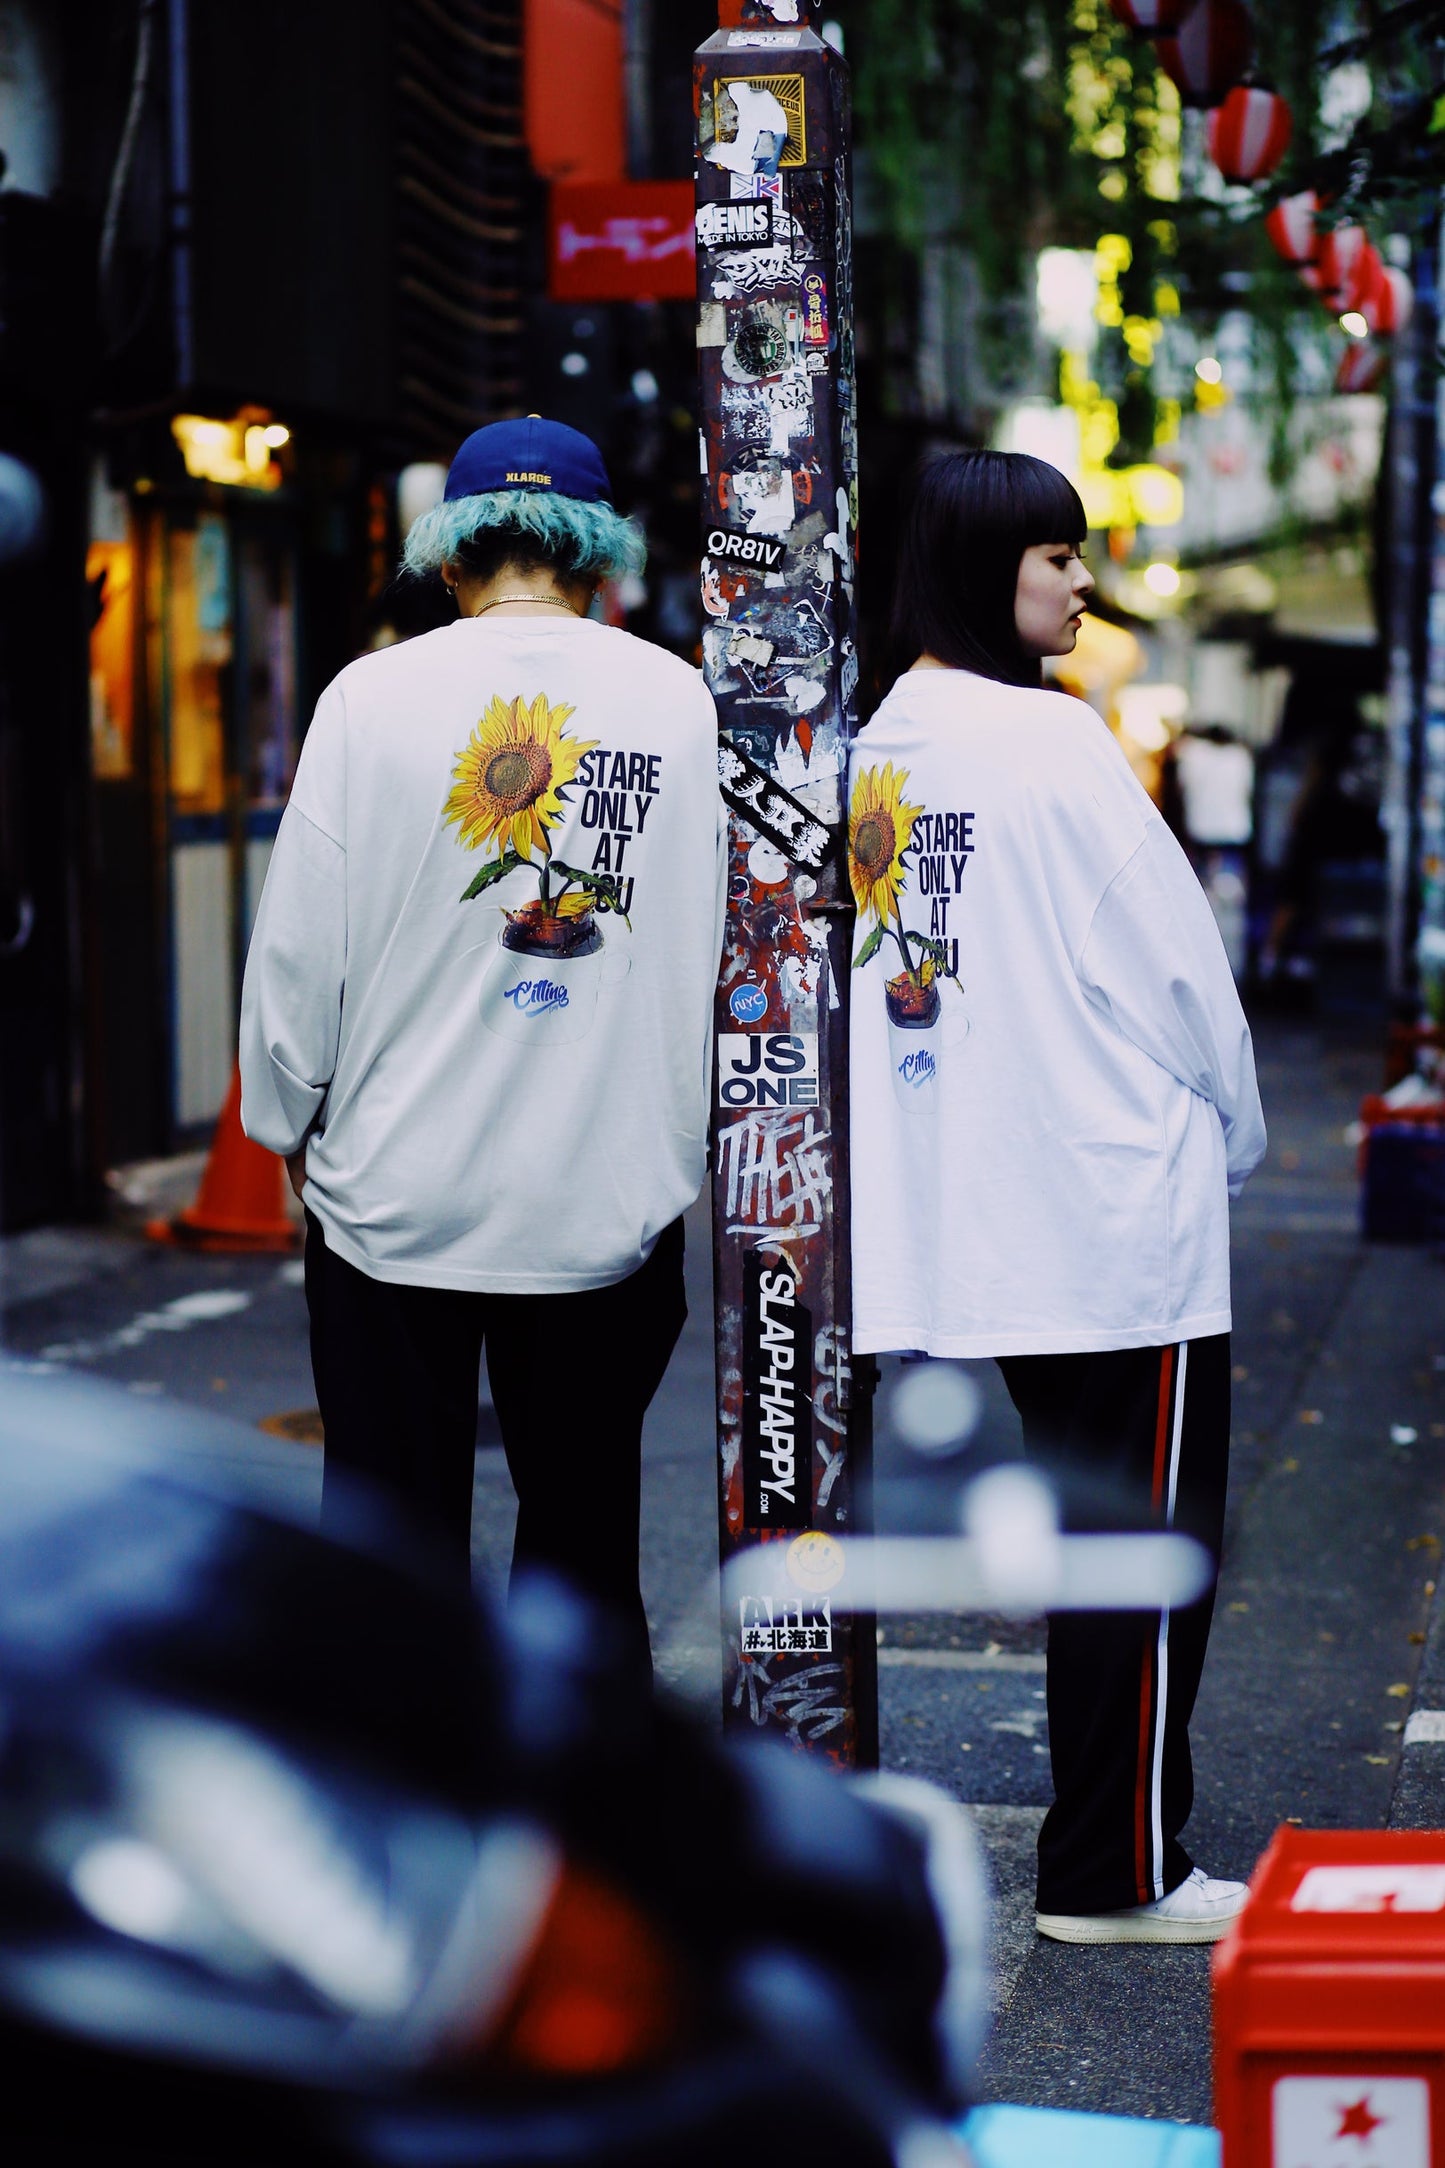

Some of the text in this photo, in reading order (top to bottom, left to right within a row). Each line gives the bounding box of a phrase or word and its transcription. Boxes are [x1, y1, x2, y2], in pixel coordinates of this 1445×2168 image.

[697, 204, 769, 234] ENIS
[725, 233, 736, 243] IN
[737, 231, 768, 243] TOKYO
[505, 472, 552, 485] XLARGE
[707, 530, 781, 566] QR81V
[578, 749, 662, 794] STARE
[580, 789, 654, 834] ONLY
[591, 832, 633, 873] AT
[911, 812, 976, 855] STARE
[918, 854, 968, 896] ONLY
[930, 896, 951, 937] AT
[734, 993, 763, 1012] NYC
[731, 1034, 806, 1075] JS
[721, 1076, 819, 1107] ONE
[743, 1596, 830, 1628] ARK
